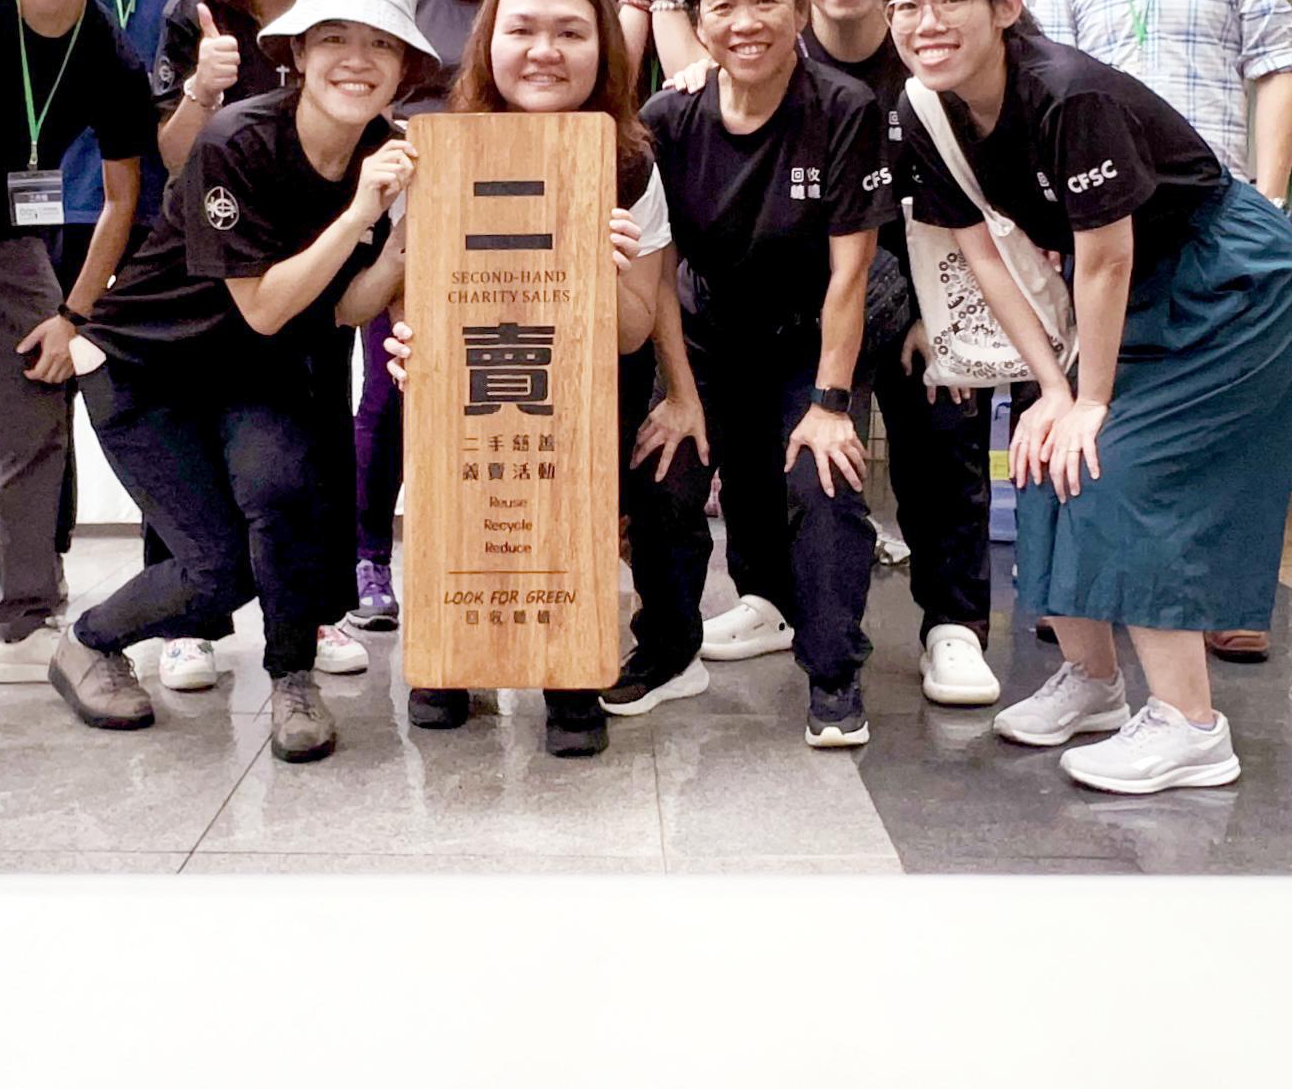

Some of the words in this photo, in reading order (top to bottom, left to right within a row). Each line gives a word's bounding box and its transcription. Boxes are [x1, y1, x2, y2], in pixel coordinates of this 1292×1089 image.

[862, 167, 893, 192] CFS
[1067, 159, 1118, 194] CFSC
[465, 180, 553, 251] 二
[451, 270, 567, 285] SECOND-HAND
[447, 290, 518, 304] CHARITY
[521, 289, 571, 304] SALES
[462, 322, 556, 416] 賣
[483, 518, 534, 534] Recycle
[484, 541, 533, 554] Reduce
[443, 591, 485, 605] LOOK
[489, 590, 520, 605] FOR
[525, 590, 577, 605] GREEN
